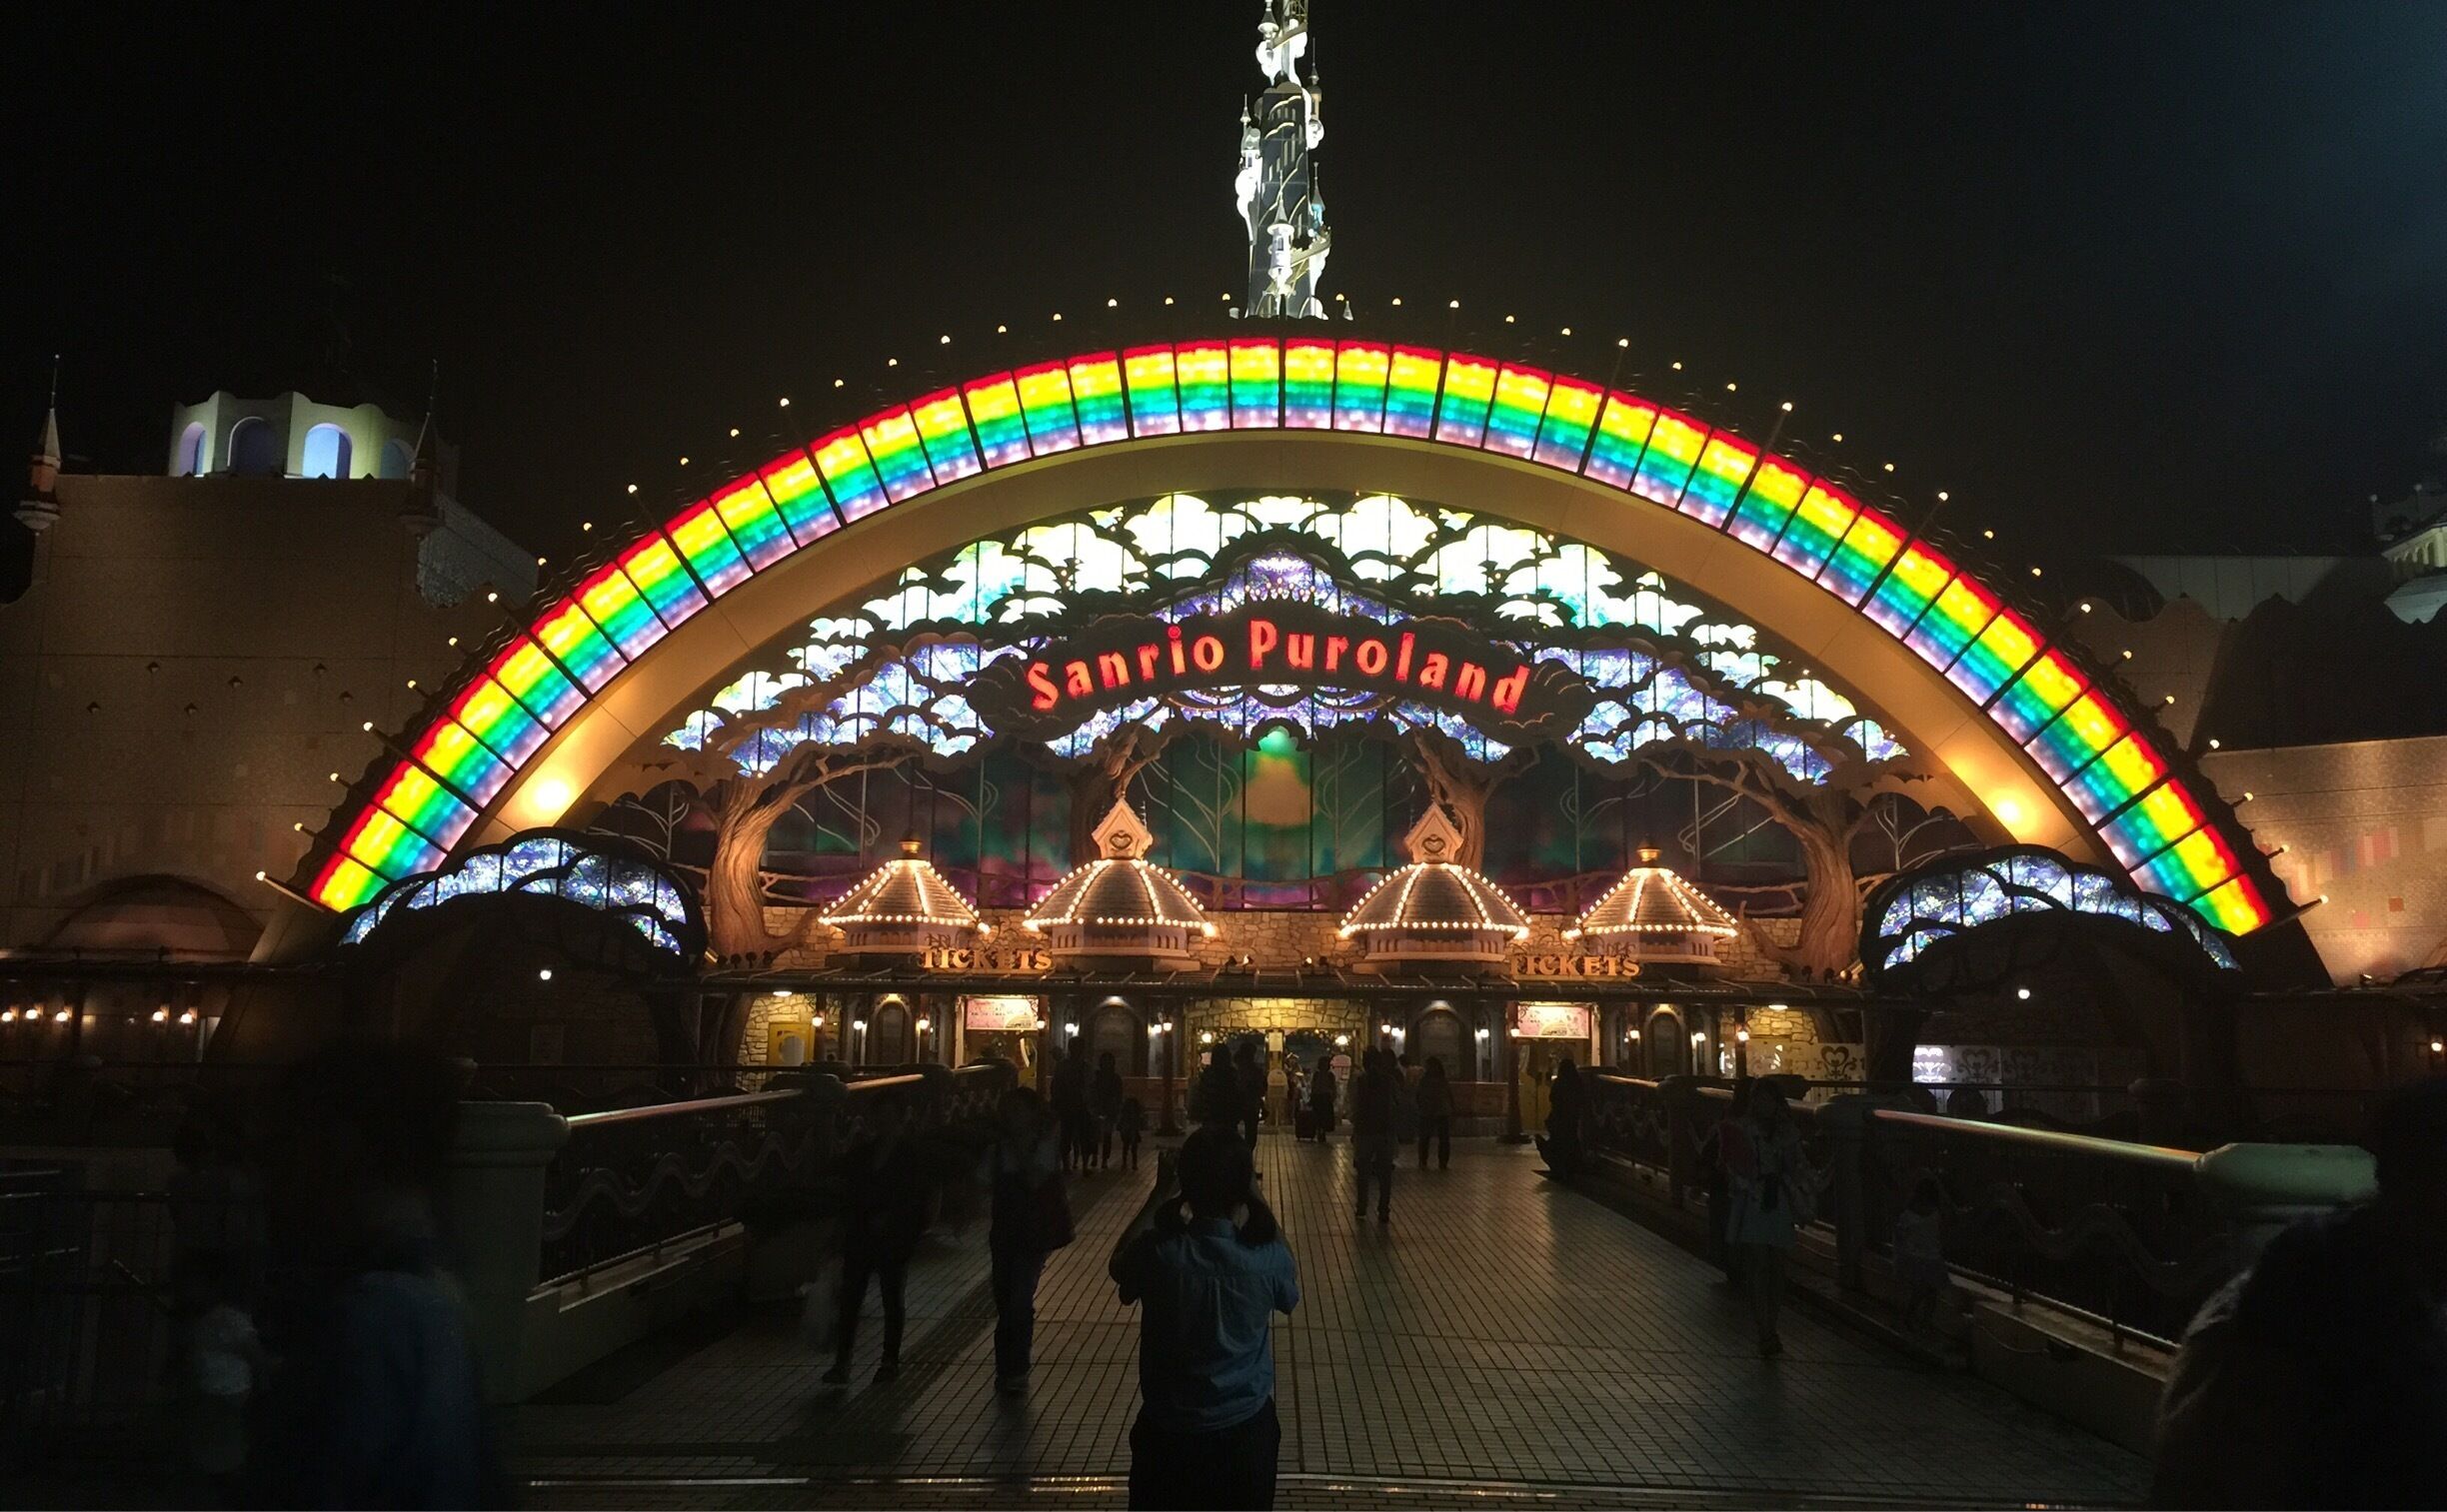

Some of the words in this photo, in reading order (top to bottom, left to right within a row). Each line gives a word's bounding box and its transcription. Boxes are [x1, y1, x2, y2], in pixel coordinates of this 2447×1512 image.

[1027, 626, 1224, 711] Sanrio
[1249, 620, 1531, 716] Puroland
[920, 947, 1053, 970] TICKETS
[1510, 952, 1641, 977] TICKETS
